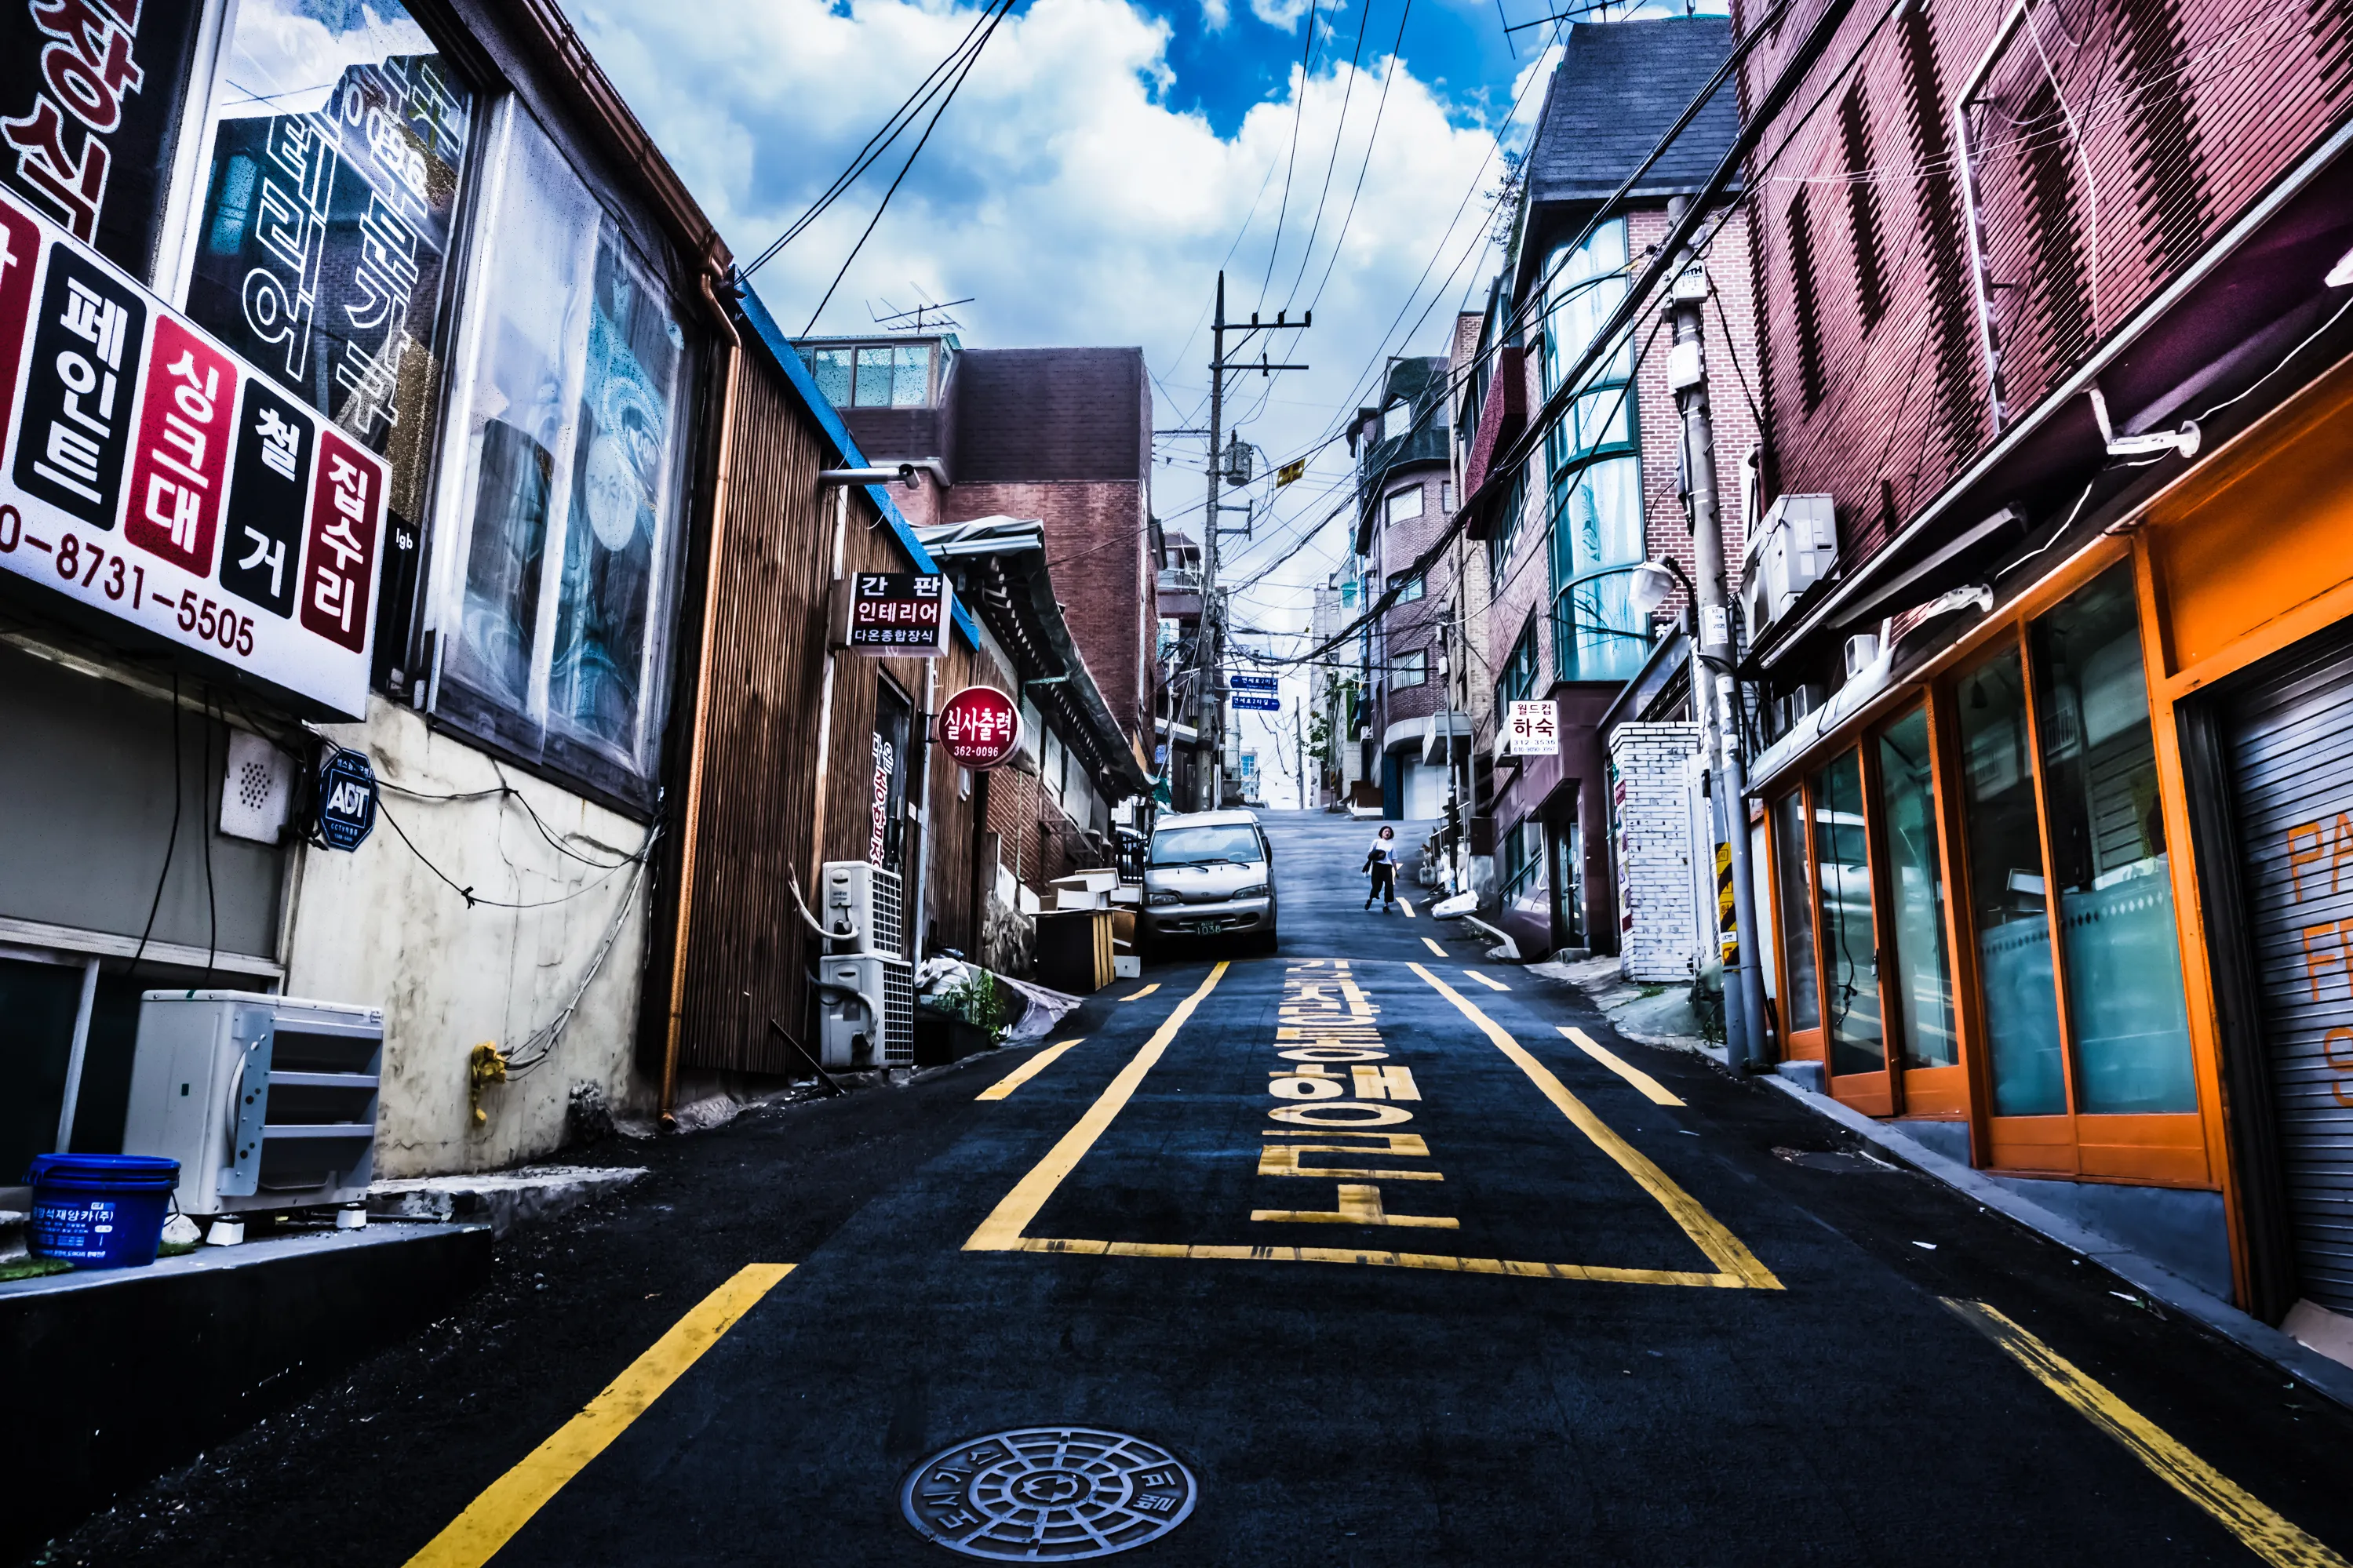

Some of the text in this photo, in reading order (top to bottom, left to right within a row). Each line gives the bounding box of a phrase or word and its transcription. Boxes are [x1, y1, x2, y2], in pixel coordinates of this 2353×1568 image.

[0, 0, 144, 248] 장식
[34, 277, 129, 504] 페인트
[146, 348, 217, 555] 싱크대
[238, 407, 300, 598] 철거
[314, 455, 368, 632] 집수리
[861, 576, 942, 597] 간판
[858, 602, 938, 624] 인테리어
[854, 629, 933, 643] 다온종합장식
[944, 706, 1012, 742] 실사출력
[1517, 704, 1551, 715] 월드컵
[1513, 718, 1554, 737] 하숙
[953, 745, 999, 757] 362-0096
[327, 780, 370, 818] ADT
[1197, 925, 1222, 935] 1038
